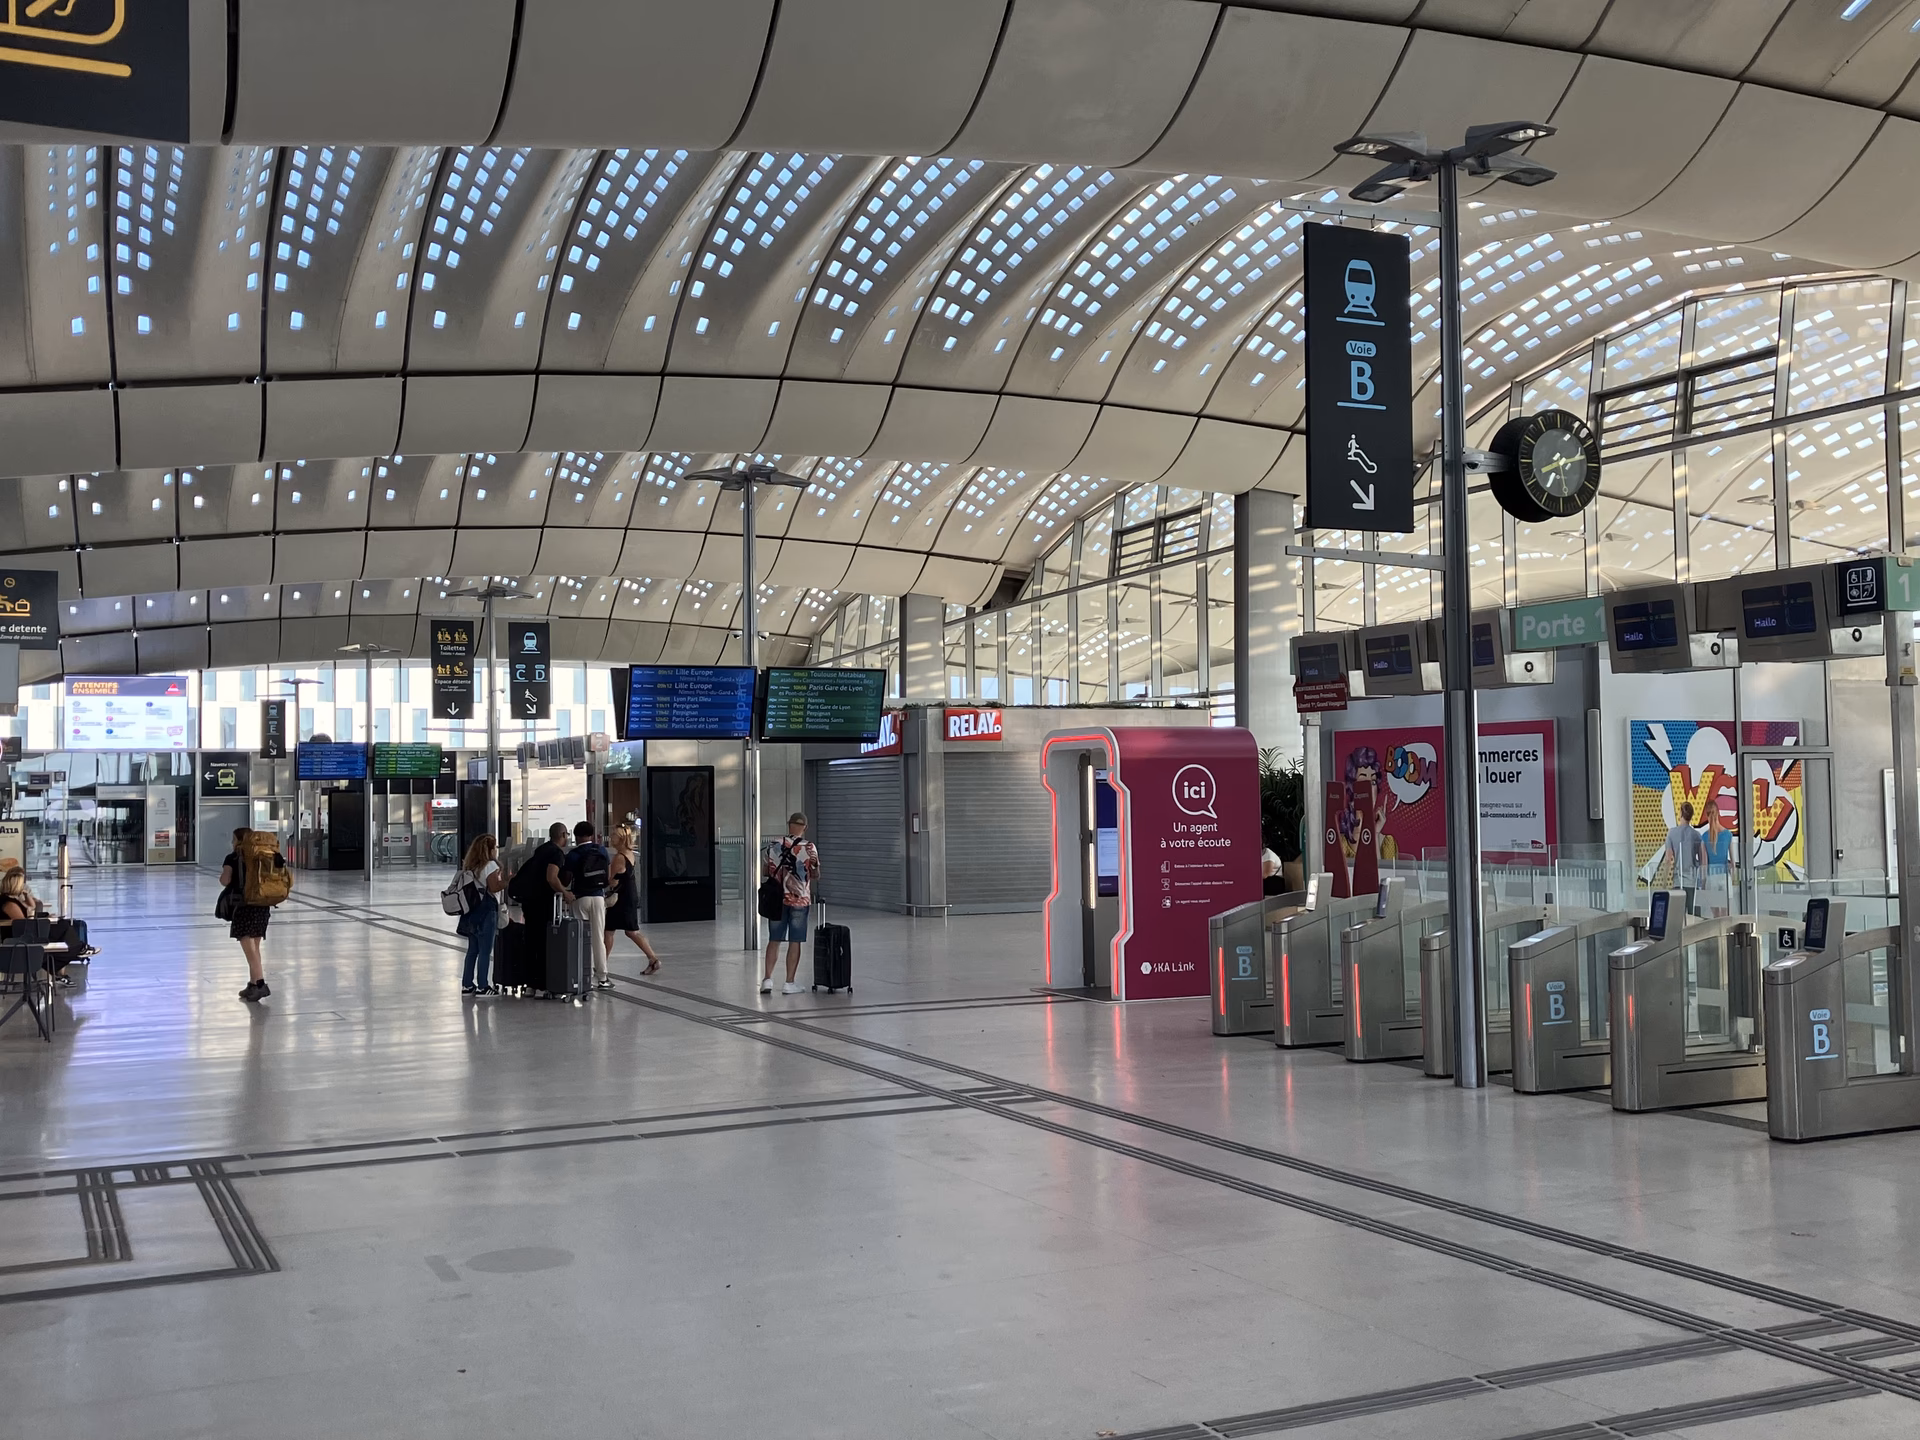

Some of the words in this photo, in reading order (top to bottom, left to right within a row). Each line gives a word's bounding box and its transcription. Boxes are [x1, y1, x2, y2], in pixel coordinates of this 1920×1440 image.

[1349, 342, 1372, 355] Voie
[1350, 360, 1375, 401] B
[1898, 573, 1911, 602] 1
[1521, 613, 1586, 641] Porte
[516, 669, 526, 680] C
[535, 669, 545, 680] D
[690, 669, 713, 677] Europe
[690, 682, 713, 690] Europe
[848, 685, 864, 693] Lyon
[673, 702, 700, 710] Perpignan
[270, 724, 277, 733] E
[596, 740, 603, 749] 2
[1478, 749, 1539, 764] mmerces
[1385, 745, 1438, 788] BOOM
[1485, 766, 1522, 784] louer
[1183, 781, 1206, 799] ici
[1480, 802, 1514, 810] nseignez-vous
[1481, 810, 1538, 818] tail-connexions-sncf.fr
[1173, 821, 1187, 833] Un
[1190, 822, 1218, 835] agent
[1160, 837, 1167, 848] à
[1169, 838, 1195, 848] votre
[1197, 837, 1231, 848] écoute
[1172, 961, 1195, 972] Link
[1238, 956, 1252, 977] B
[1548, 982, 1564, 990] Voie
[1549, 994, 1565, 1020] B
[1811, 1010, 1829, 1020] Voie
[1813, 1023, 1831, 1054] B
